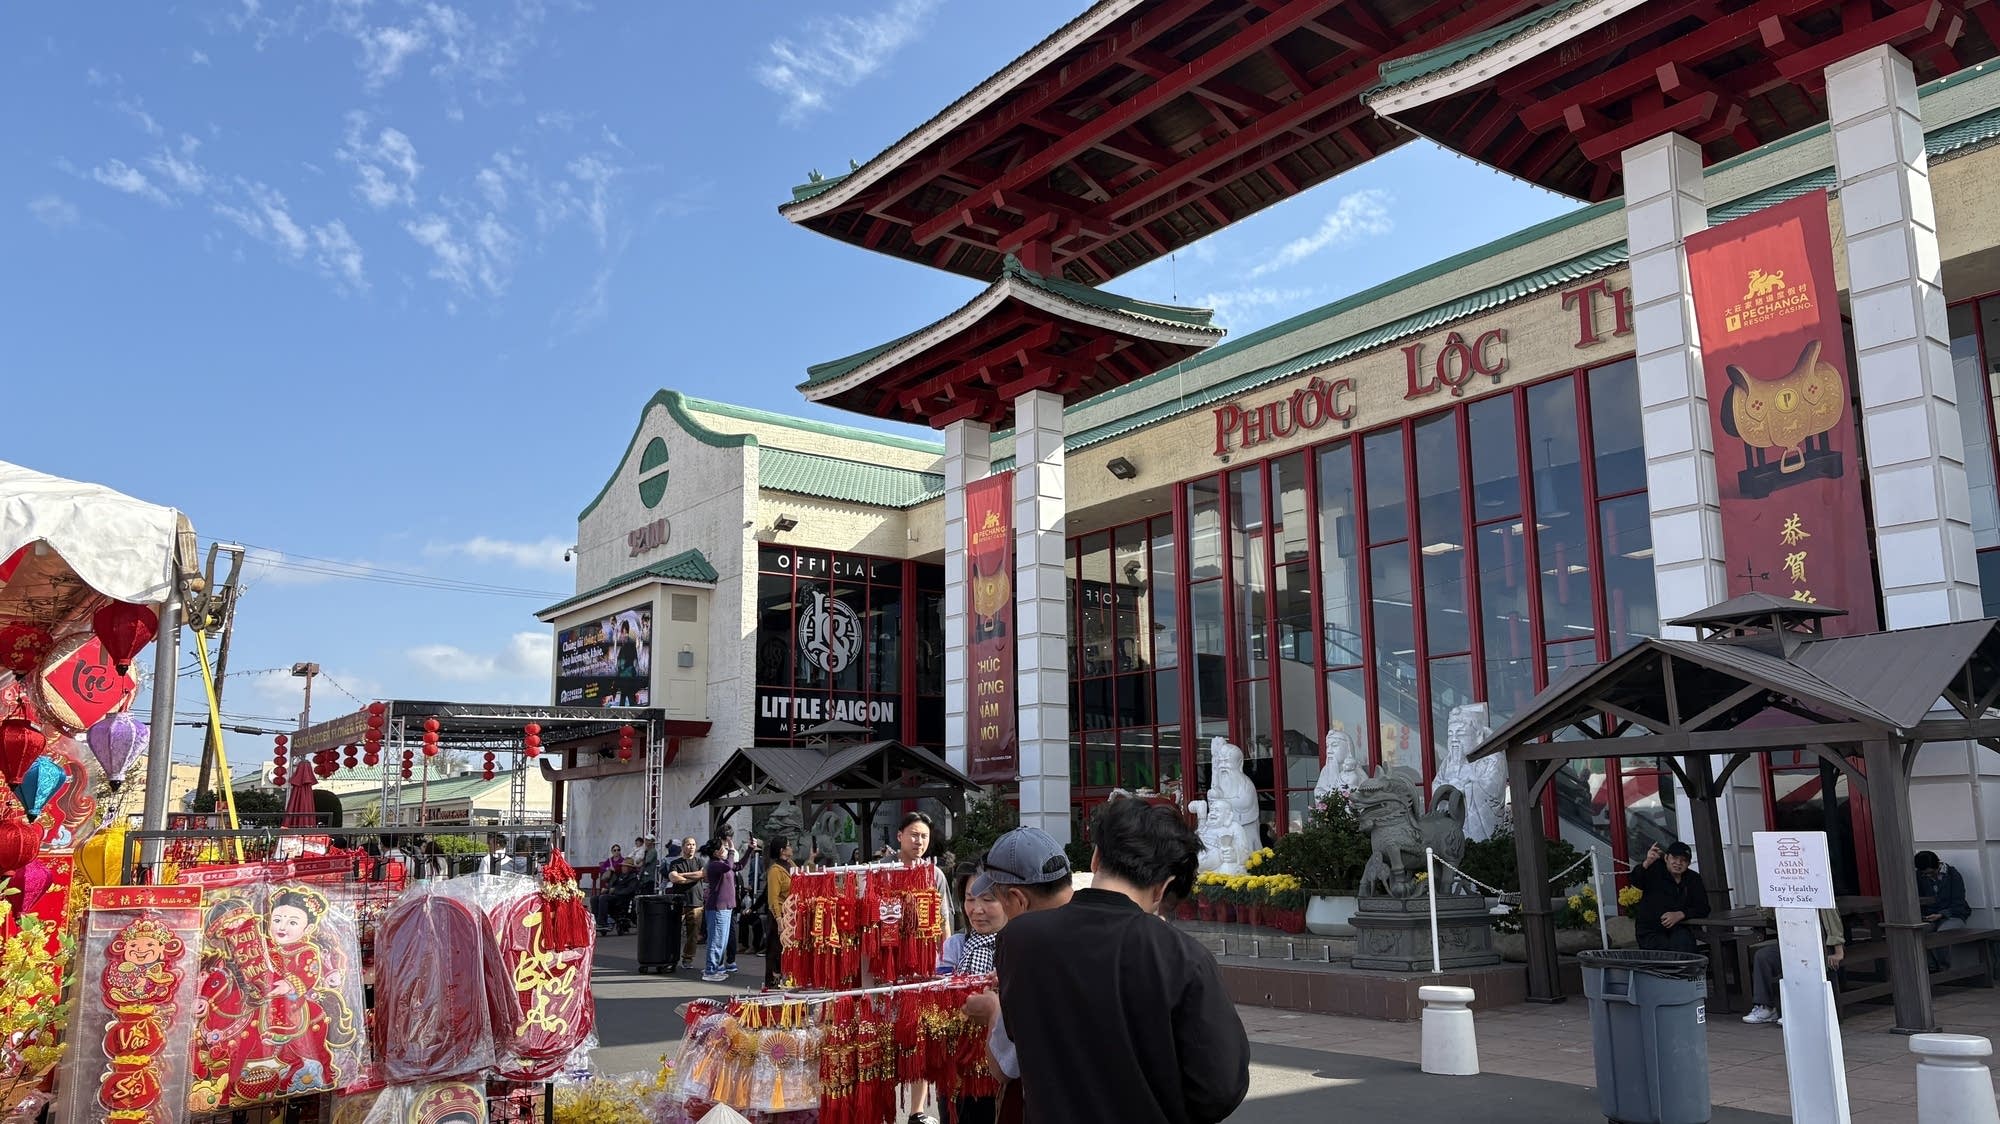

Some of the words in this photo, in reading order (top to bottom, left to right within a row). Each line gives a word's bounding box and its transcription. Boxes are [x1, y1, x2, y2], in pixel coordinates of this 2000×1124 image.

[1743, 293, 1808, 320] PECHANGA
[1744, 313, 1774, 327] RESORT
[1213, 377, 1357, 456] PHƯỚC
[1401, 328, 1508, 400] LỘC
[1561, 279, 1633, 350] TH
[979, 525, 1007, 537] PECHANG
[777, 555, 877, 578] OFFICIAL
[977, 679, 1004, 696] ỪNG
[761, 696, 821, 719] LITTLE
[825, 699, 894, 723] SAIGON
[355, 719, 367, 732] FES
[1769, 885, 1786, 893] Stay
[1788, 885, 1819, 894] Healthy
[1778, 895, 1795, 903] Stay
[1796, 895, 1813, 903] Safe
